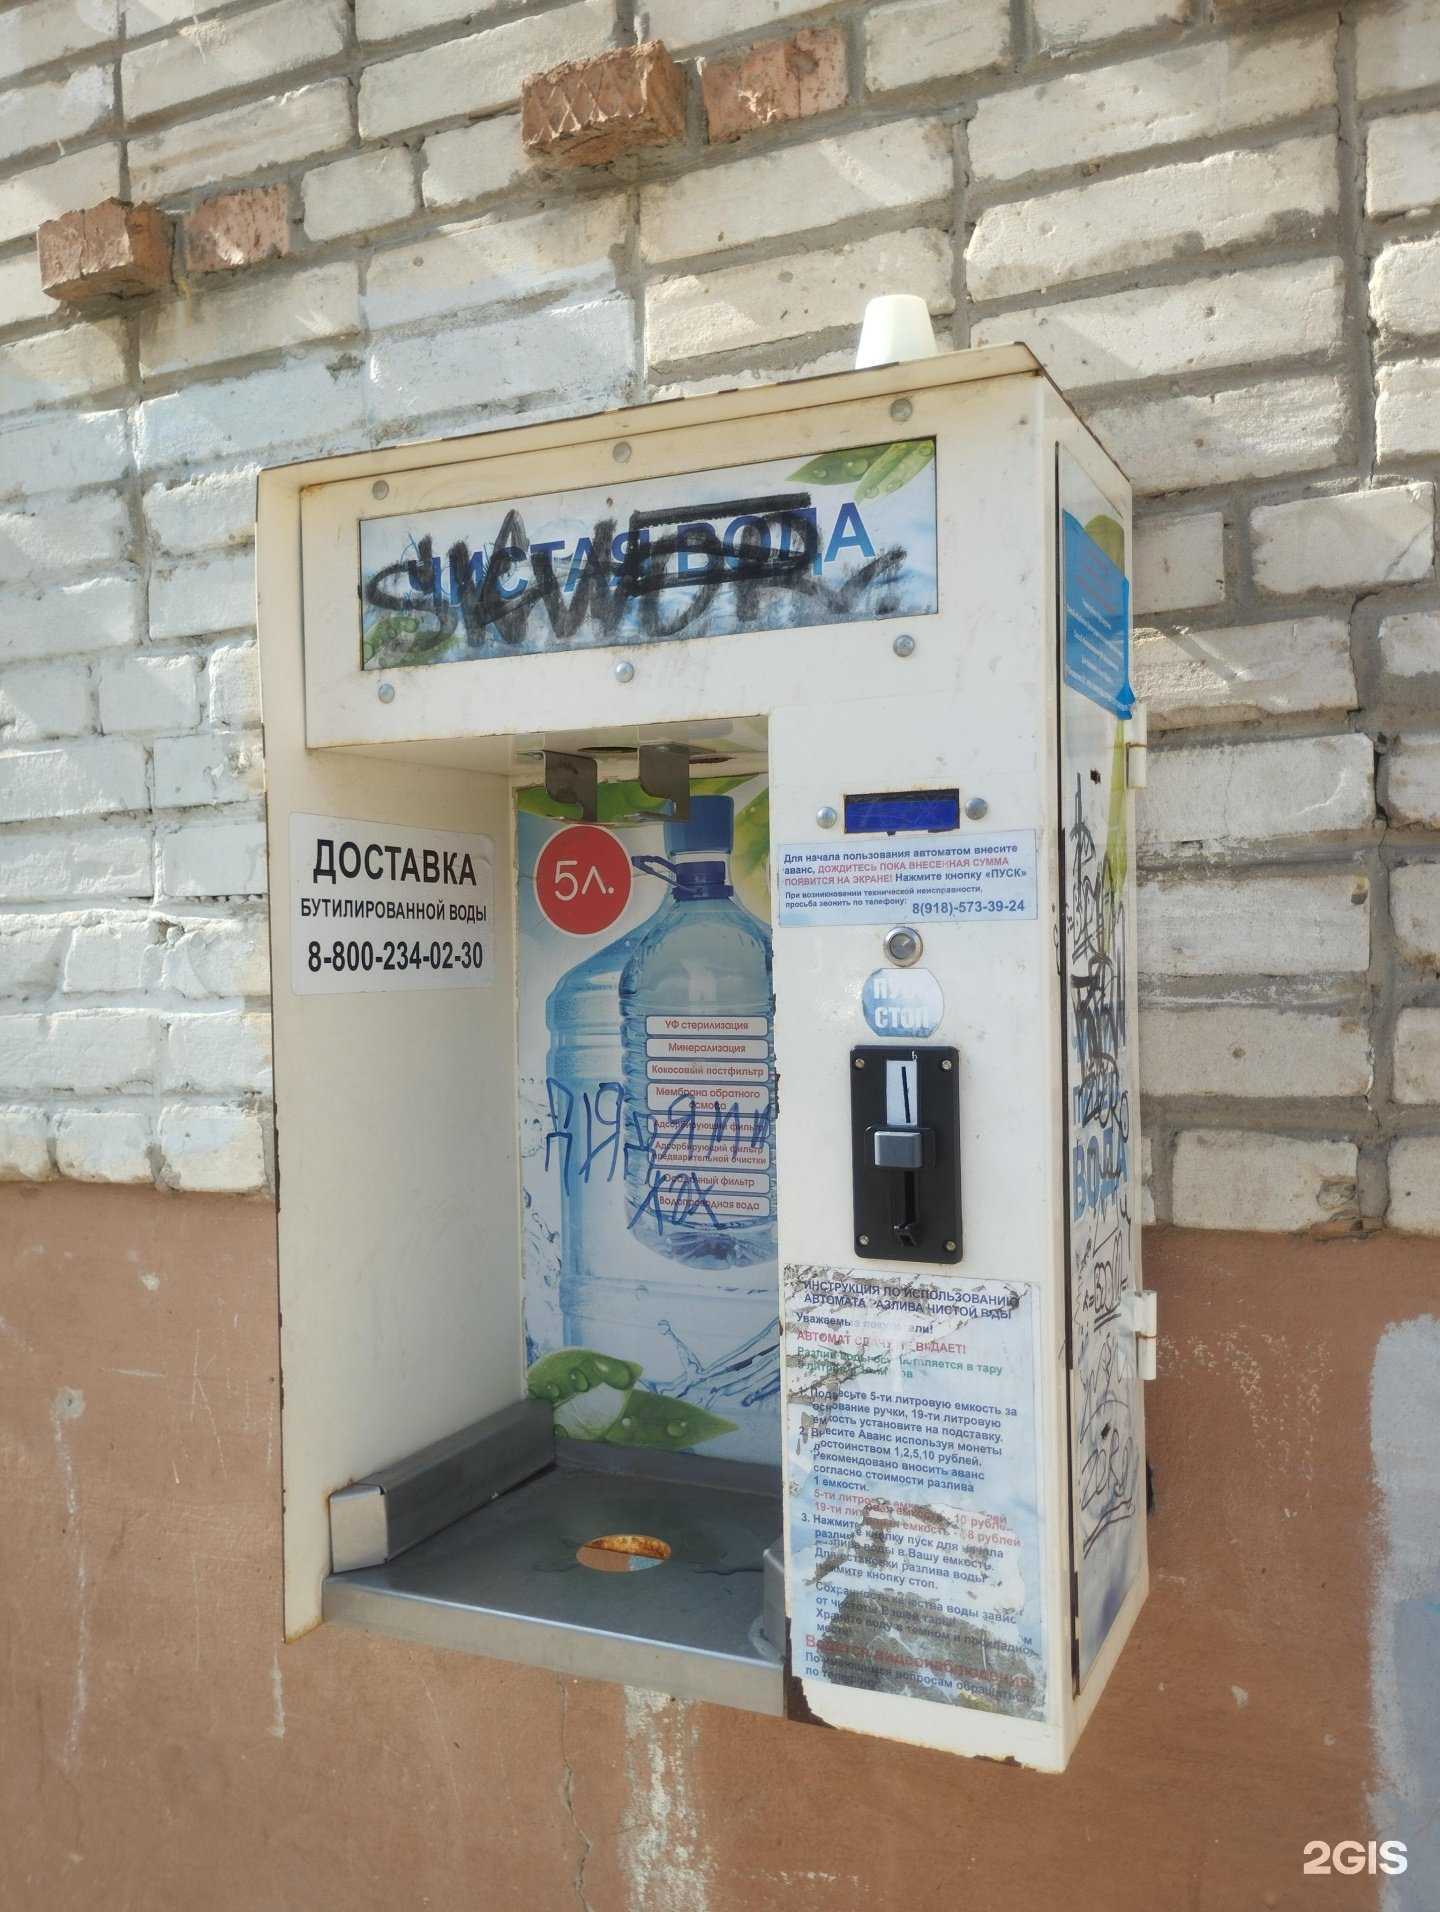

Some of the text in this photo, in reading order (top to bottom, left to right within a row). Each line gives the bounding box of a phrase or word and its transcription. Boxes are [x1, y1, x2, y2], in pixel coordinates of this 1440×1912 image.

[677, 502, 875, 577] ВОДА
[313, 839, 477, 886] ДОСТАВКА
[784, 844, 1017, 864] Для начала пользования автоматом внесите
[784, 866, 815, 876] аванс,
[818, 862, 877, 874] ДОЖДИТЕСЬ
[879, 861, 906, 871] ПОКА
[973, 857, 1008, 867] СУММА
[784, 876, 835, 887] ПОЯВИТСЯ
[837, 876, 850, 884] НА
[895, 871, 942, 882] Нажмите
[945, 870, 982, 881] кнопку
[985, 868, 1026, 878] «ПУСК»
[785, 885, 983, 900] При возникновении технической неисправности,
[301, 898, 486, 924] БУТИЛИРОВАННОЙ ВОДЫ
[785, 899, 817, 910] просьба
[819, 899, 850, 907] звонить
[865, 896, 907, 908] телефону:
[912, 899, 1024, 915] 8(918)-573-39-24
[308, 940, 482, 972] 8-800-234-02-30
[665, 1020, 748, 1031] УФ стерилизация
[669, 1043, 746, 1053] Минерализация
[652, 1064, 764, 1078] Кокосовый постфильтр
[656, 1087, 760, 1100] Мембрана обратного
[732, 1155, 766, 1164] очистки
[721, 1176, 755, 1186] фильтр
[736, 1200, 759, 1210] вода
[804, 1281, 880, 1295] ИНСТРУКЦИЯ
[884, 1286, 900, 1296] ПО
[805, 1294, 865, 1308] АВТОМАТА
[928, 1305, 977, 1318] ЧИСТОЙ
[794, 1328, 850, 1345] АВТОМАТ
[978, 1364, 1002, 1376] тару
[870, 1392, 892, 1402] 5-ти
[895, 1396, 951, 1410] литровую
[955, 1402, 1001, 1415] емкость
[1005, 1408, 1018, 1416] за
[812, 1402, 1001, 1429] основание ручки, 19-ти литровую
[860, 1417, 922, 1433] установите
[926, 1426, 938, 1434] на
[942, 1427, 1003, 1444] подставку.
[858, 1430, 892, 1442] Аванс
[895, 1435, 954, 1451] используя
[958, 1443, 1002, 1456] монеты
[814, 1440, 982, 1467] достоинством 1,2,5,10 рублей.
[814, 1451, 985, 1480] Рекомендовано вносить аванс
[813, 1465, 974, 1492] согласно стоимости разлива
[814, 1476, 869, 1492] 1 емкости.
[814, 1489, 835, 1499] 5-ти
[815, 1502, 841, 1513] 19-ти
[903, 1522, 950, 1535] емкость
[801, 1513, 810, 1522] 3.
[907, 1536, 933, 1547] пуск
[936, 1541, 959, 1551] для
[908, 1548, 939, 1564] Вашу
[867, 1572, 905, 1586] кнопку
[909, 1577, 938, 1590] стоп.
[902, 1562, 950, 1577] разлива
[953, 1571, 985, 1583] воды
[947, 1605, 979, 1617] воды
[805, 1667, 819, 1675] по
